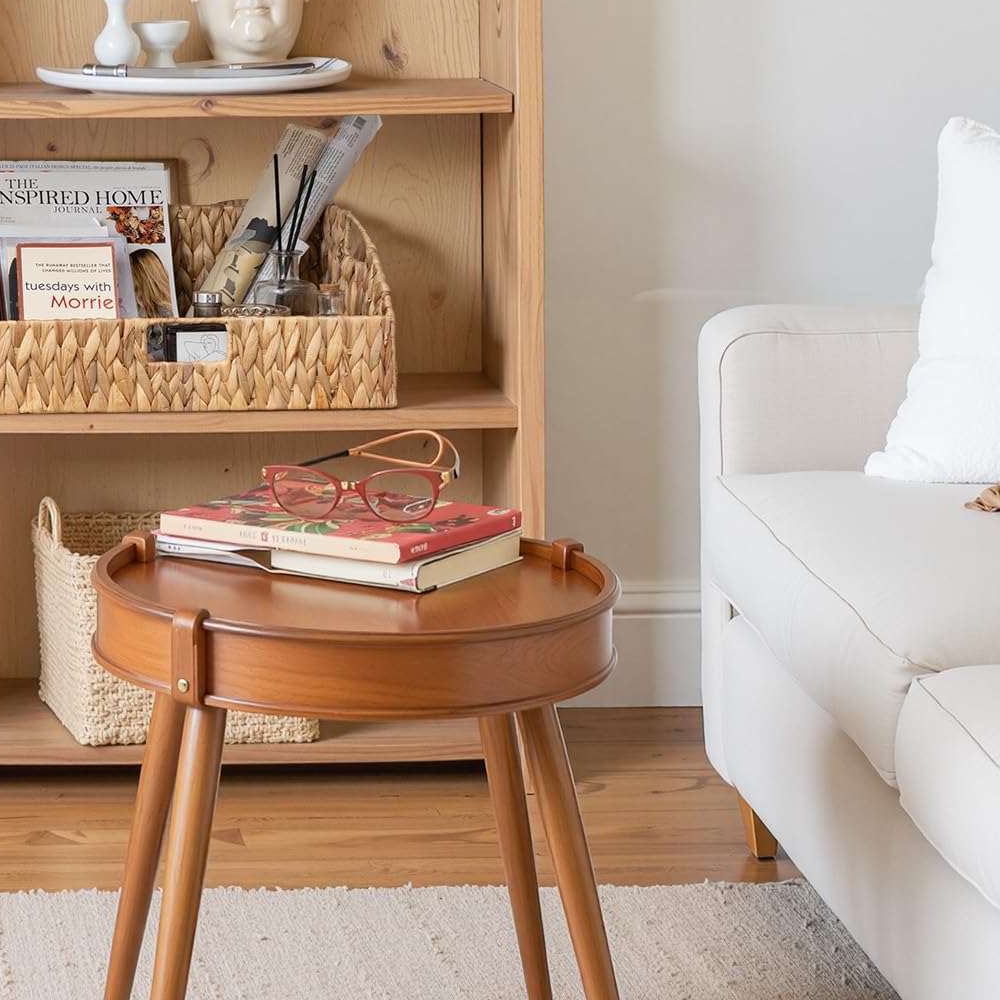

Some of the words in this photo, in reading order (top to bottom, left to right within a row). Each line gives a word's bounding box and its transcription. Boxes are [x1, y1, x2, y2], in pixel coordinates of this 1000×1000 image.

[6, 179, 38, 189] THE
[96, 190, 163, 205] HOME
[53, 206, 102, 214] JOURNAL
[25, 282, 80, 292] tuesdays
[84, 282, 111, 291] with
[51, 295, 114, 309] Morrie
